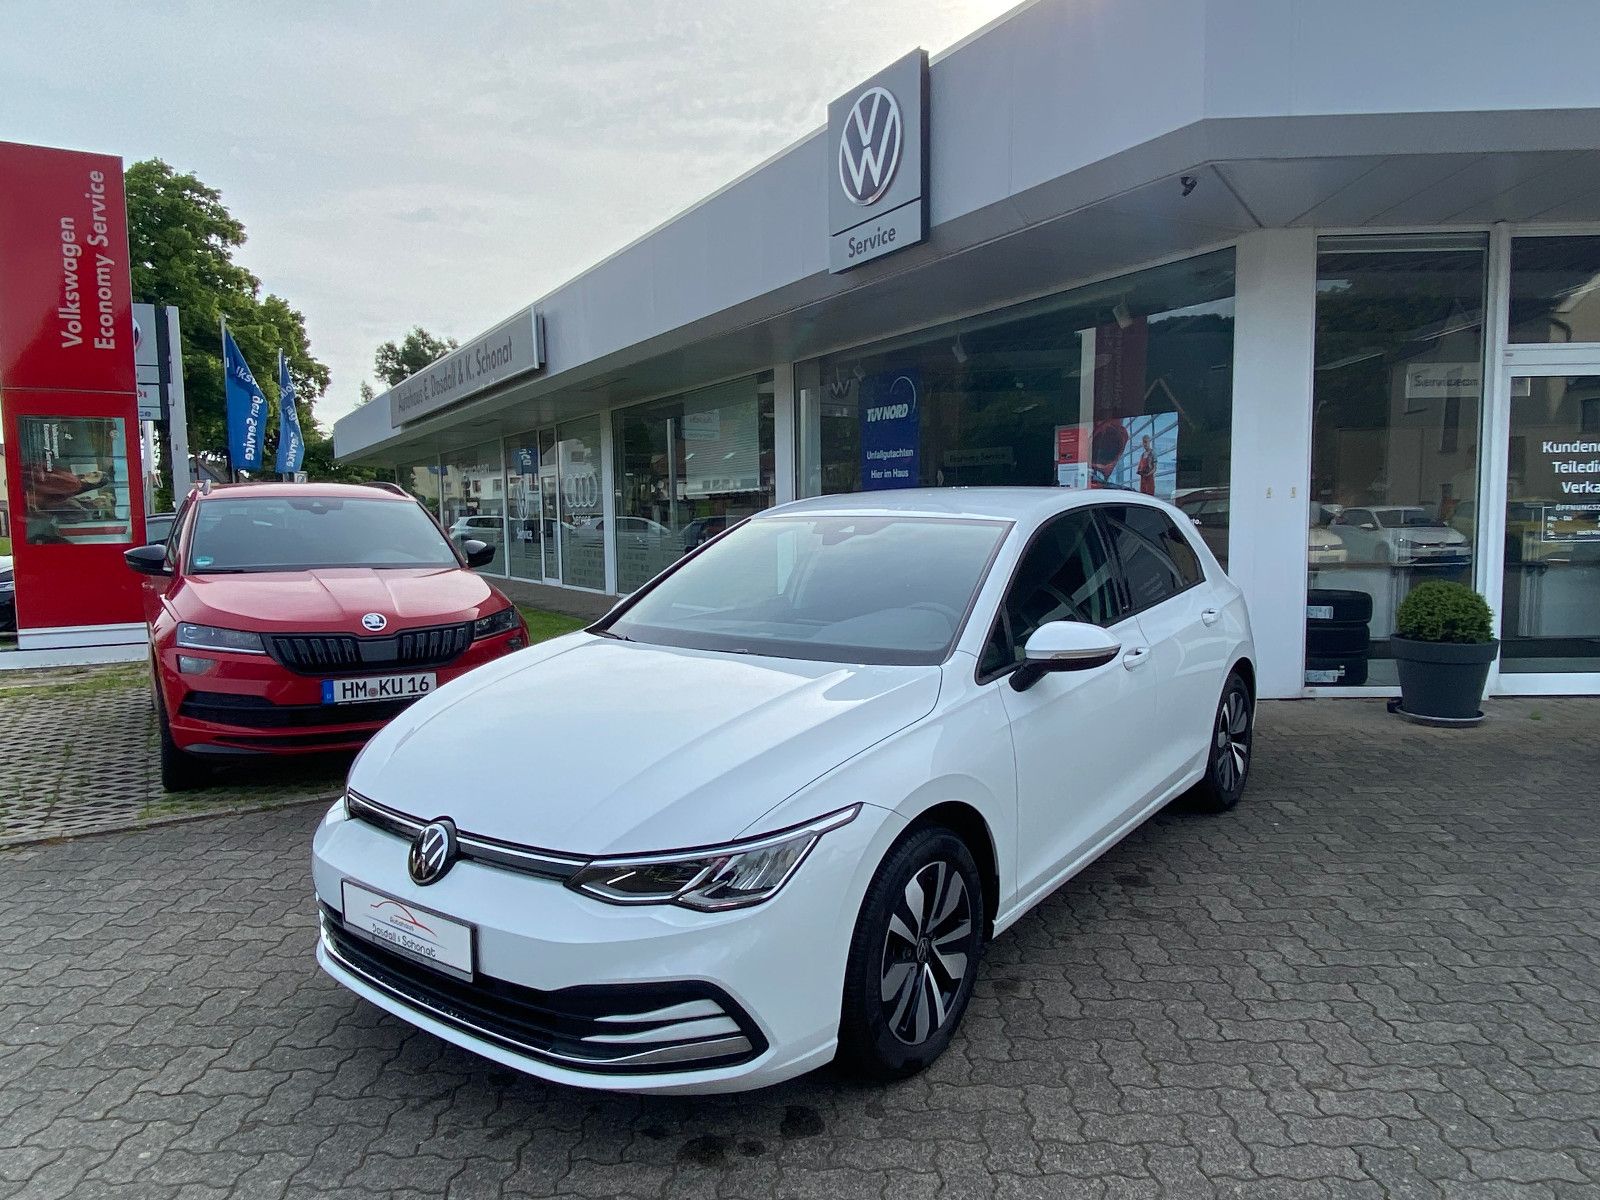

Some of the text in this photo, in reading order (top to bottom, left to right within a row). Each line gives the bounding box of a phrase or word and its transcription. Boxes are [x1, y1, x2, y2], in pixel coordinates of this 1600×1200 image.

[848, 227, 896, 258] Service
[85, 170, 116, 350] Economy Service
[58, 216, 83, 349] Volkswagen
[465, 353, 475, 381] K.
[476, 335, 513, 377] Schonat
[883, 403, 909, 420] NORD
[866, 448, 914, 461] Unfallgutachten
[1542, 440, 1600, 453] Kunden
[870, 468, 909, 479] Hier im Haus
[1552, 460, 1600, 473] Teiledi
[342, 681, 367, 699] HM
[379, 677, 403, 696] KU
[407, 676, 430, 693] 16
